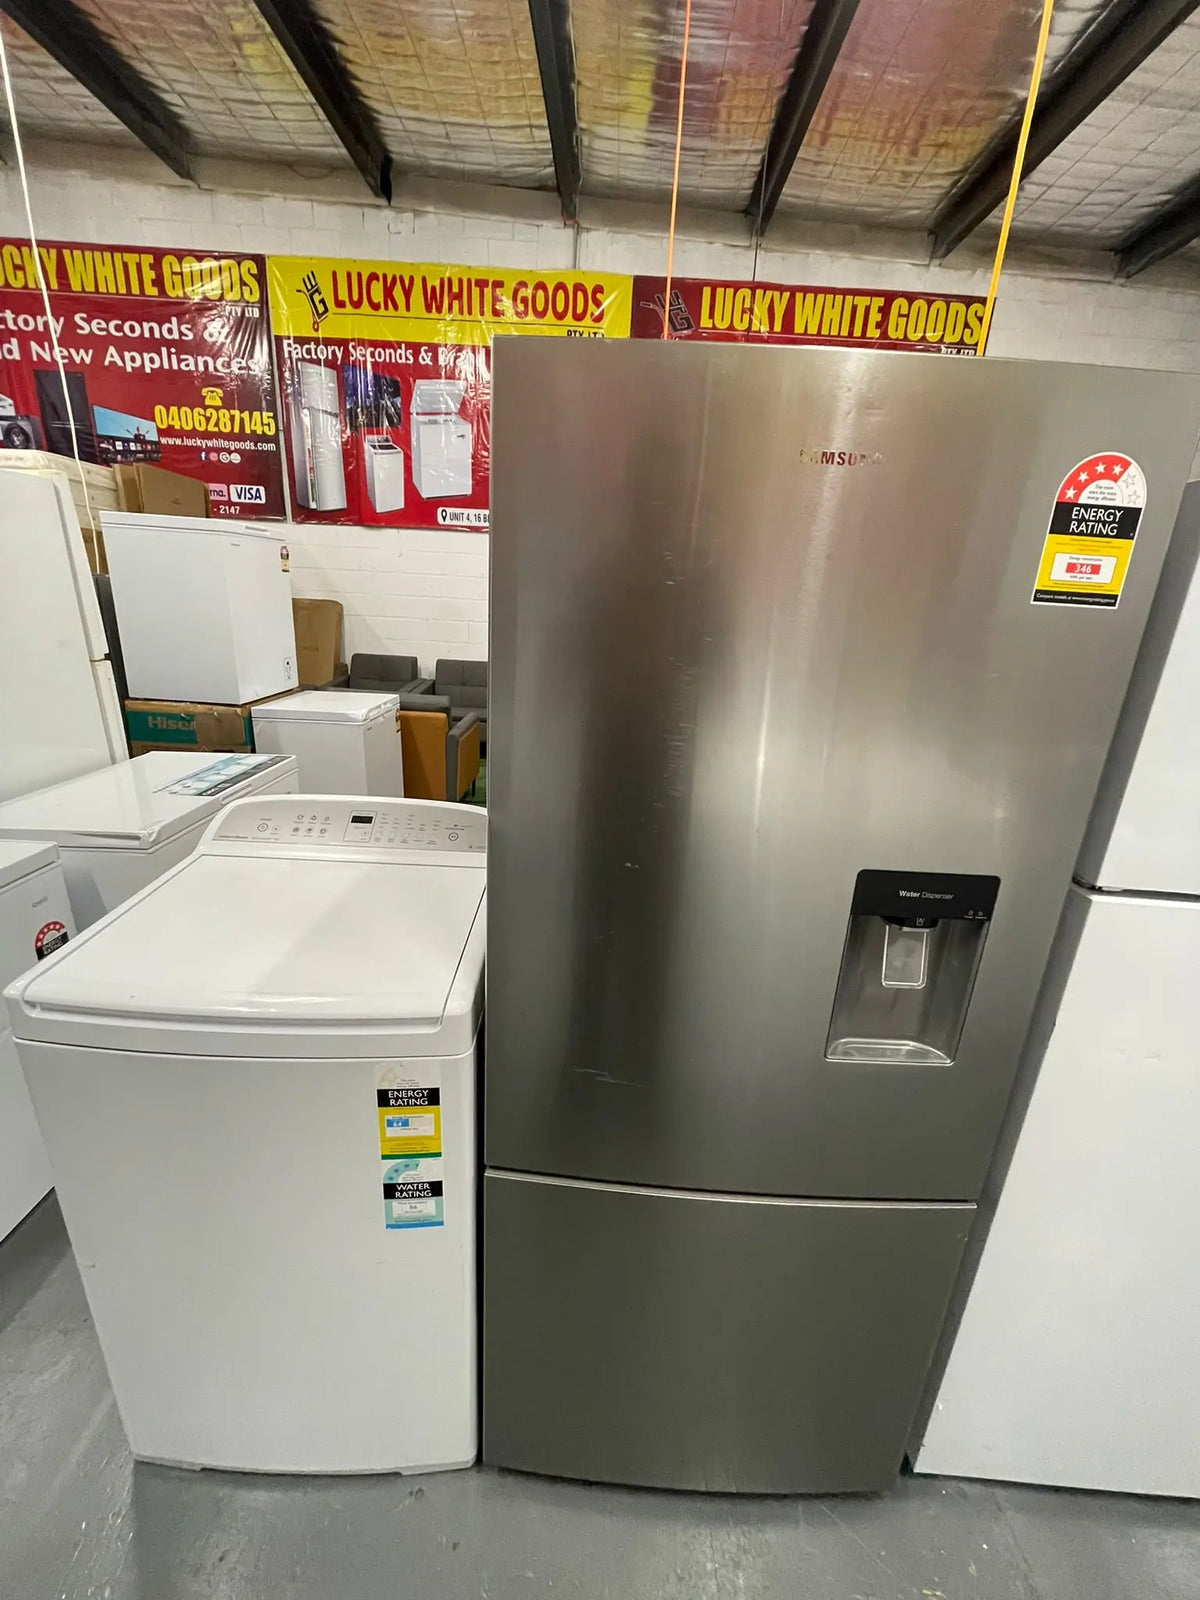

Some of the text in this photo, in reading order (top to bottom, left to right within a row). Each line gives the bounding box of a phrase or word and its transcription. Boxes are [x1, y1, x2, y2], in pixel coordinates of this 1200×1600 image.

[0, 244, 260, 304] CKY WHITE GOODS
[332, 270, 606, 323] LUCKY WHITE GOODS
[225, 305, 260, 318] PTY LTD
[700, 286, 986, 345] LUCKY WHITE GOODS
[74, 313, 194, 341] Seconds
[203, 317, 230, 344] &
[0, 338, 260, 375] d New Appliances
[282, 338, 343, 362] Factory
[348, 341, 414, 364] Seconds
[419, 345, 433, 366] &
[154, 404, 276, 436] 0406287145
[160, 436, 276, 452] www.luckywhitegoods.com
[234, 486, 263, 502] VISA
[219, 505, 240, 514] 2147
[449, 511, 464, 522] UNIT
[474, 513, 481, 522] 16
[1071, 506, 1124, 522] ENERGY
[1069, 521, 1118, 536] RATING
[1075, 563, 1092, 573] 346
[899, 890, 954, 900] Water Dispenser
[388, 1089, 429, 1099] ENERGY
[389, 1097, 428, 1107] RATING
[395, 1189, 432, 1199] RATING
[396, 1182, 430, 1191] WATER
